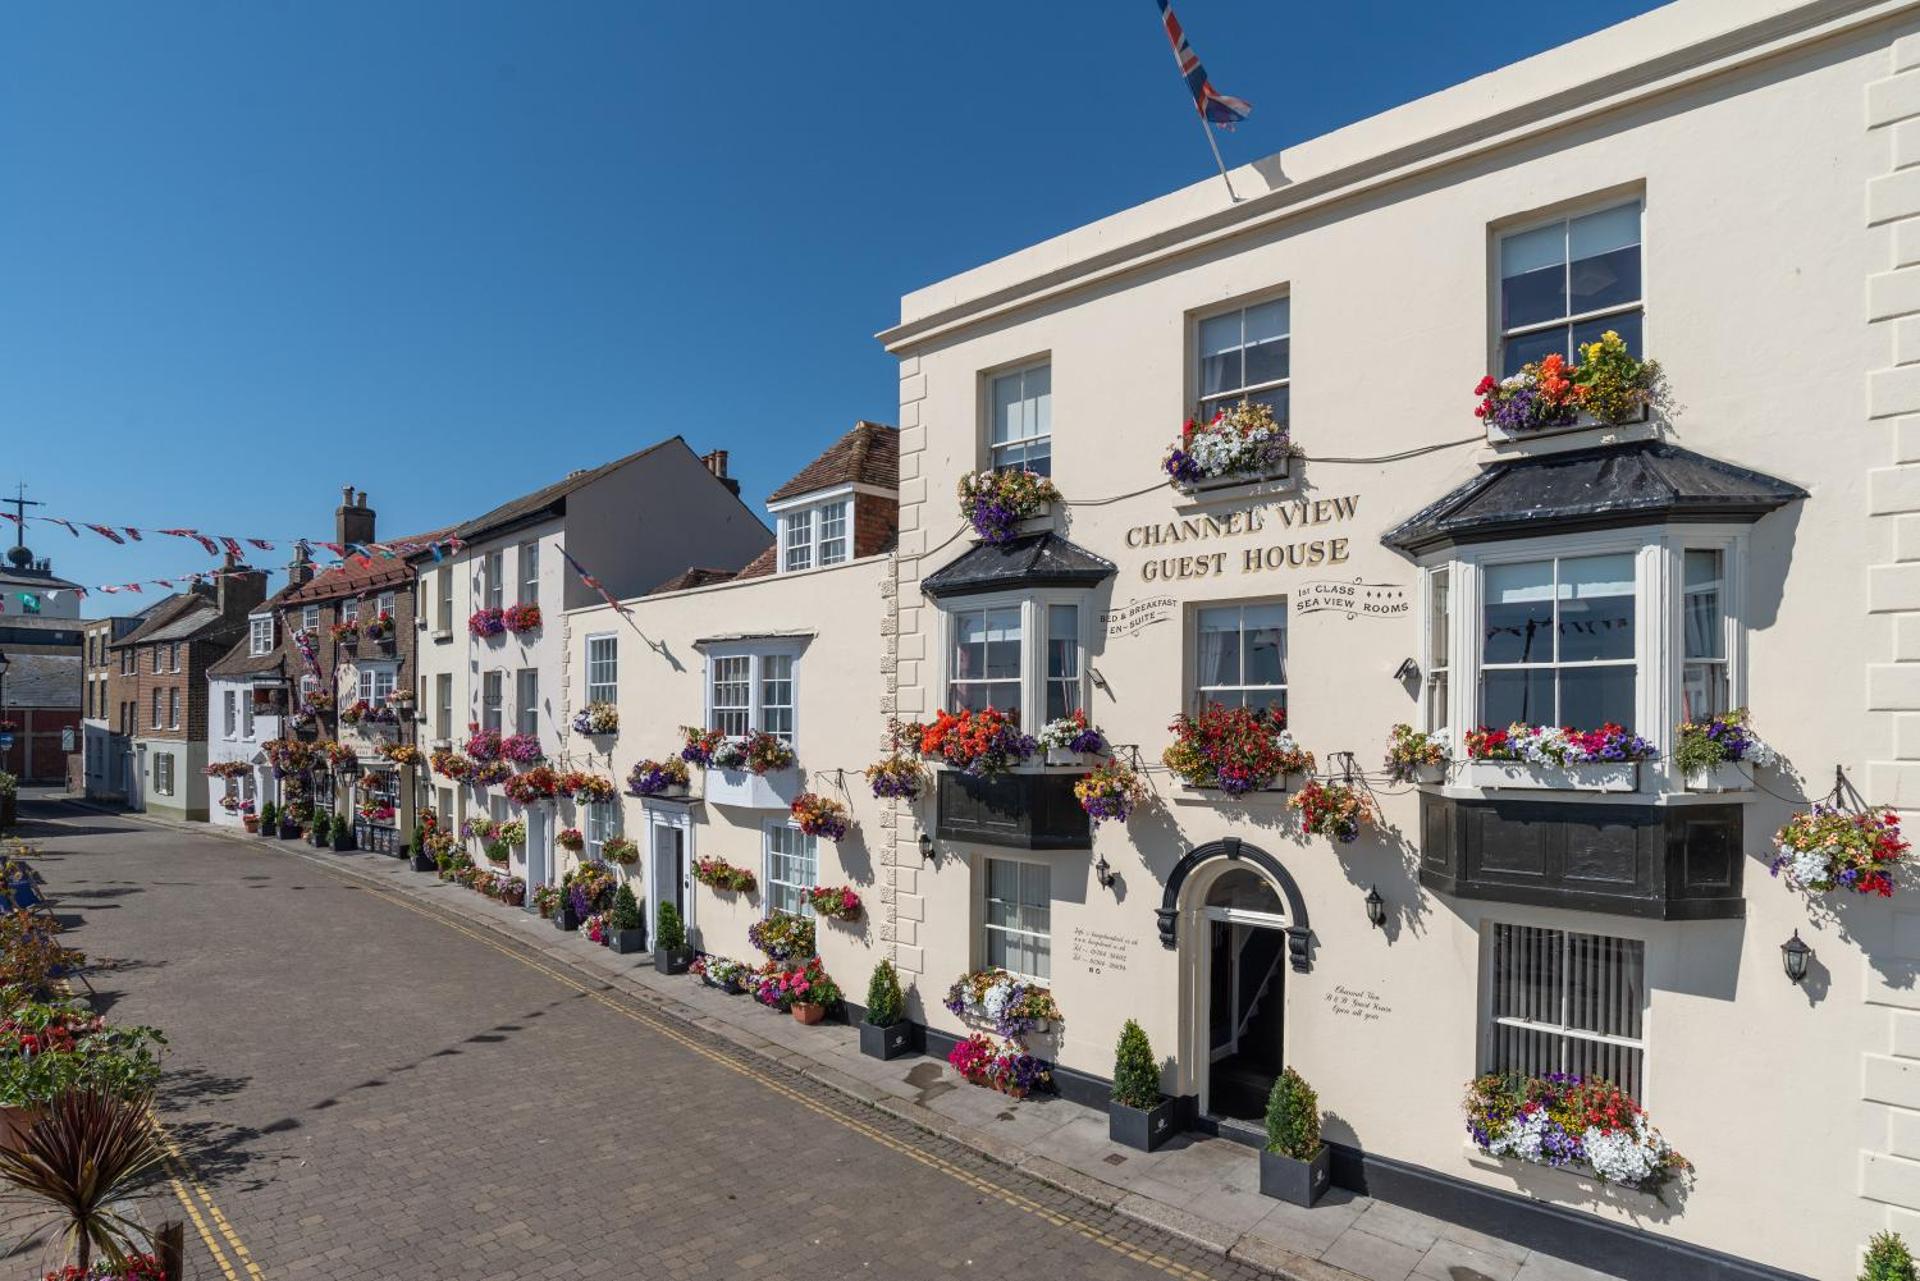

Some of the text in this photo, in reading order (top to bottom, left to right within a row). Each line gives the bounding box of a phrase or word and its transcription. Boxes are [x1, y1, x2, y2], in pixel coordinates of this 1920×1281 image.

[1125, 495, 1360, 549] CHANNEL VIEW
[1142, 537, 1350, 582] GUEST HOUSE
[1297, 584, 1355, 597] 1st CLASS
[1100, 599, 1177, 624] BED & BREAKFAST
[1297, 597, 1409, 614] SEA VIEW ROOMS
